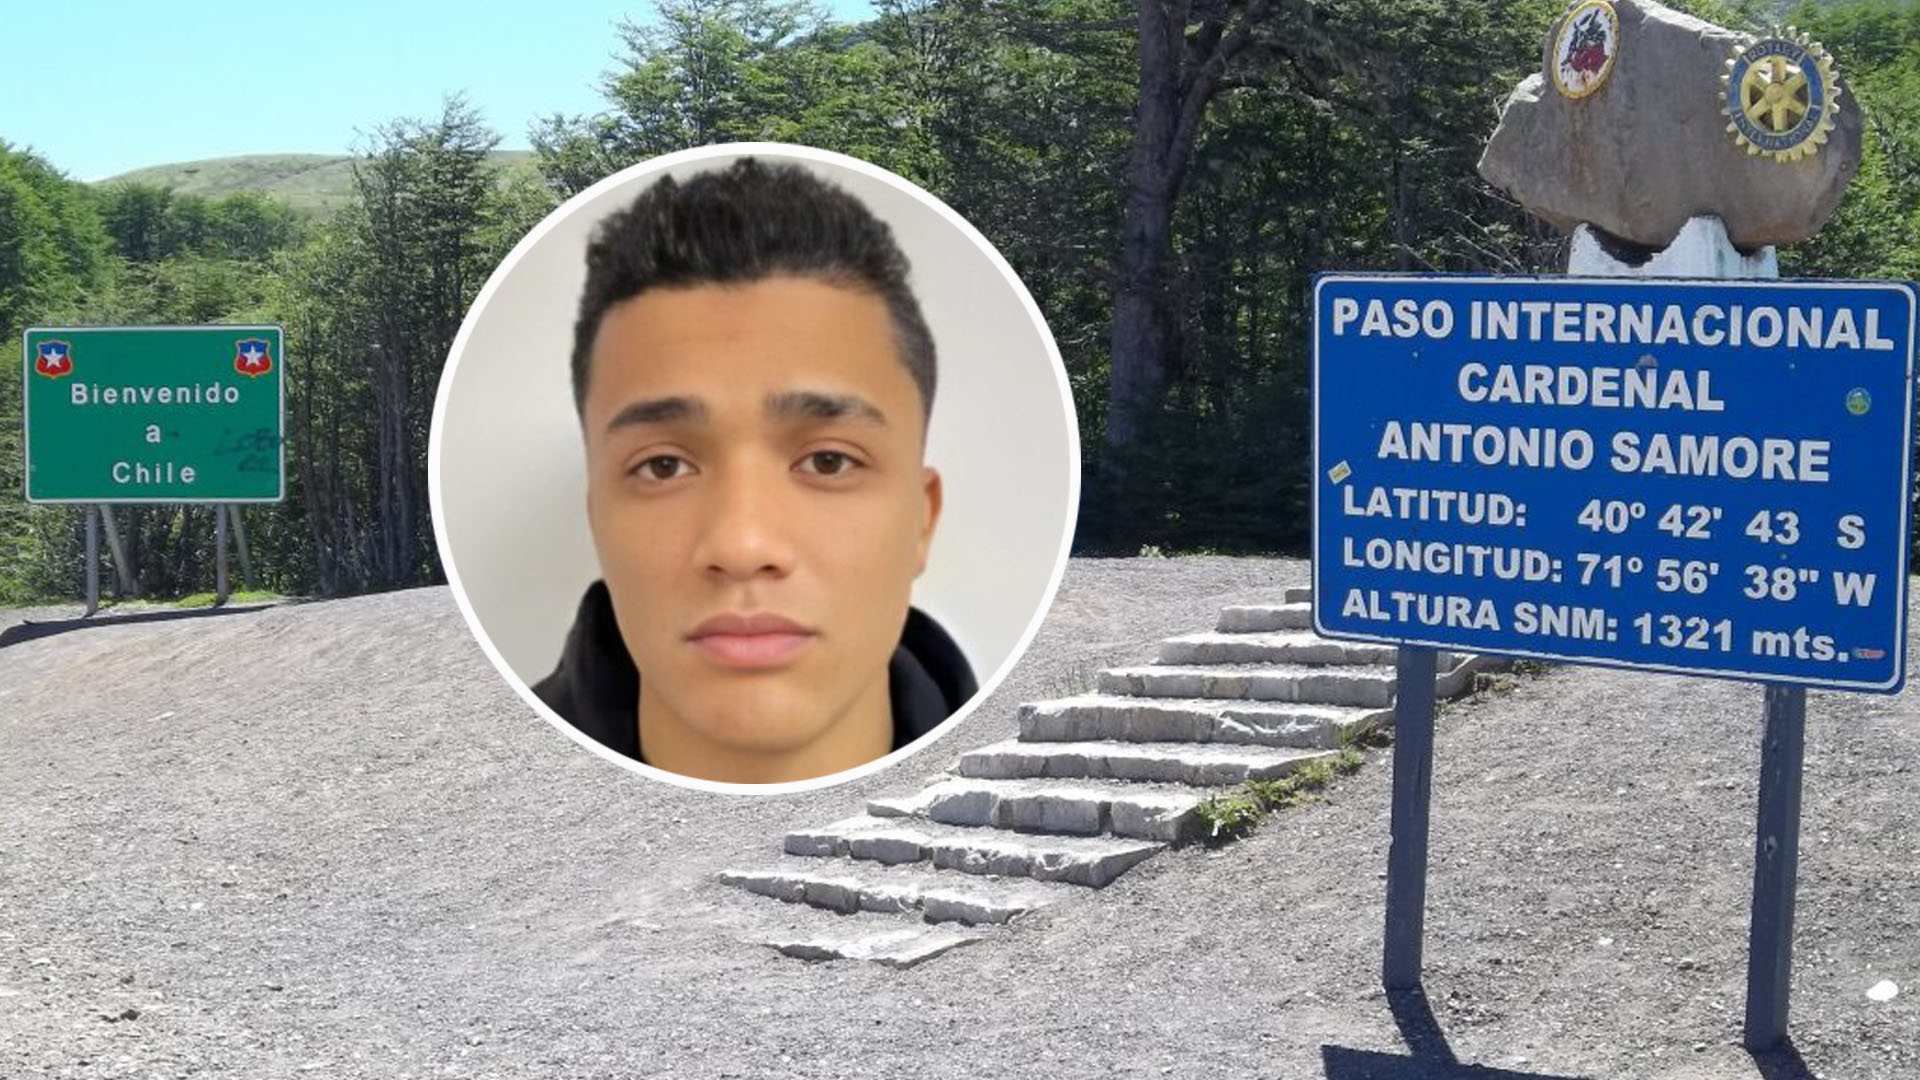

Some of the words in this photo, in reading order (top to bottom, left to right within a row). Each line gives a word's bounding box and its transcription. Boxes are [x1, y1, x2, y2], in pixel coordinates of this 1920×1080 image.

[1333, 298, 1454, 339] PASO
[1471, 301, 1894, 350] INTERNACIONAL
[71, 382, 239, 404] Bienvenido
[146, 425, 161, 443] a
[1378, 421, 1594, 470] ANTONIO
[1610, 431, 1830, 482] SAMORE
[113, 462, 195, 483] Chile
[1344, 484, 1526, 527] LATITUD:
[1658, 504, 1722, 539] 42'
[1746, 510, 1799, 545] 43
[1837, 515, 1865, 549] S
[1343, 537, 1562, 583] LONGITUD:
[1657, 559, 1719, 594] 56'
[1833, 572, 1876, 607] W
[1342, 588, 1500, 631] ALTURA
[1514, 602, 1617, 641] SNM:
[1634, 612, 1732, 652] 1321
[1752, 627, 1848, 662] mts.
